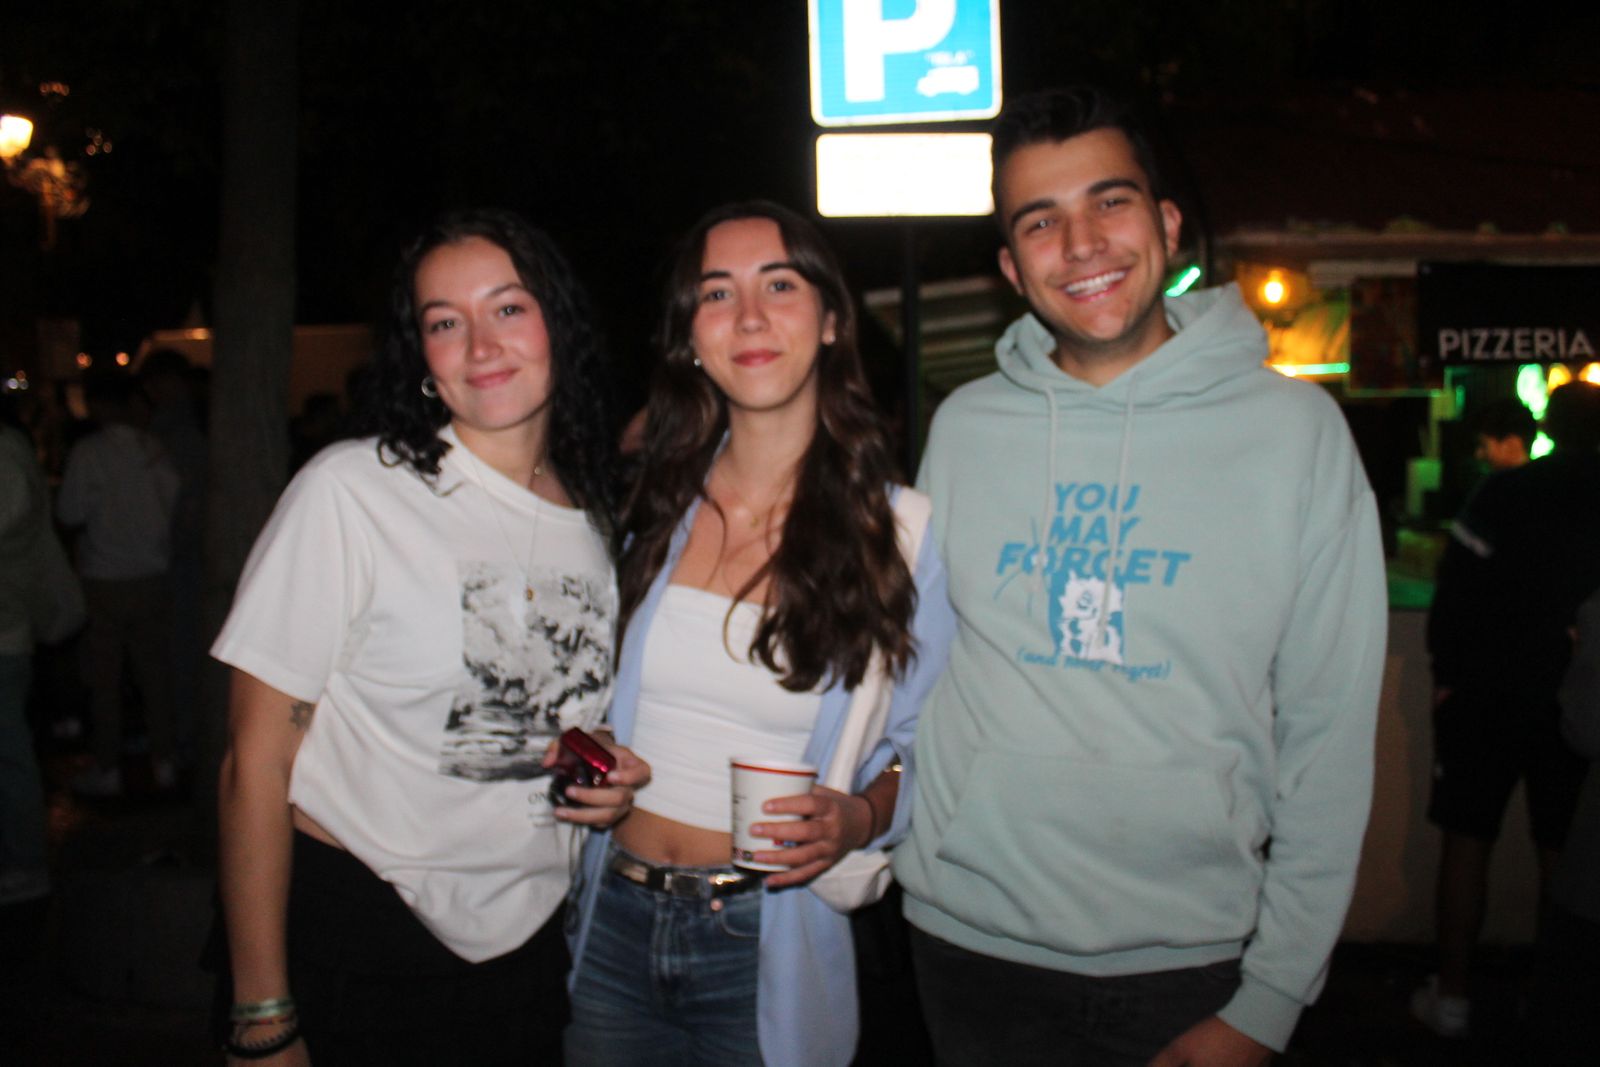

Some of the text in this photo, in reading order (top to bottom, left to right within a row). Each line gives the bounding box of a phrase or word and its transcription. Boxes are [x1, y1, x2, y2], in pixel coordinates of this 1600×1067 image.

[842, 0, 956, 103] P
[1438, 327, 1595, 360] PIZZERIA
[1055, 482, 1141, 513] YOU
[1050, 514, 1140, 546] MAY
